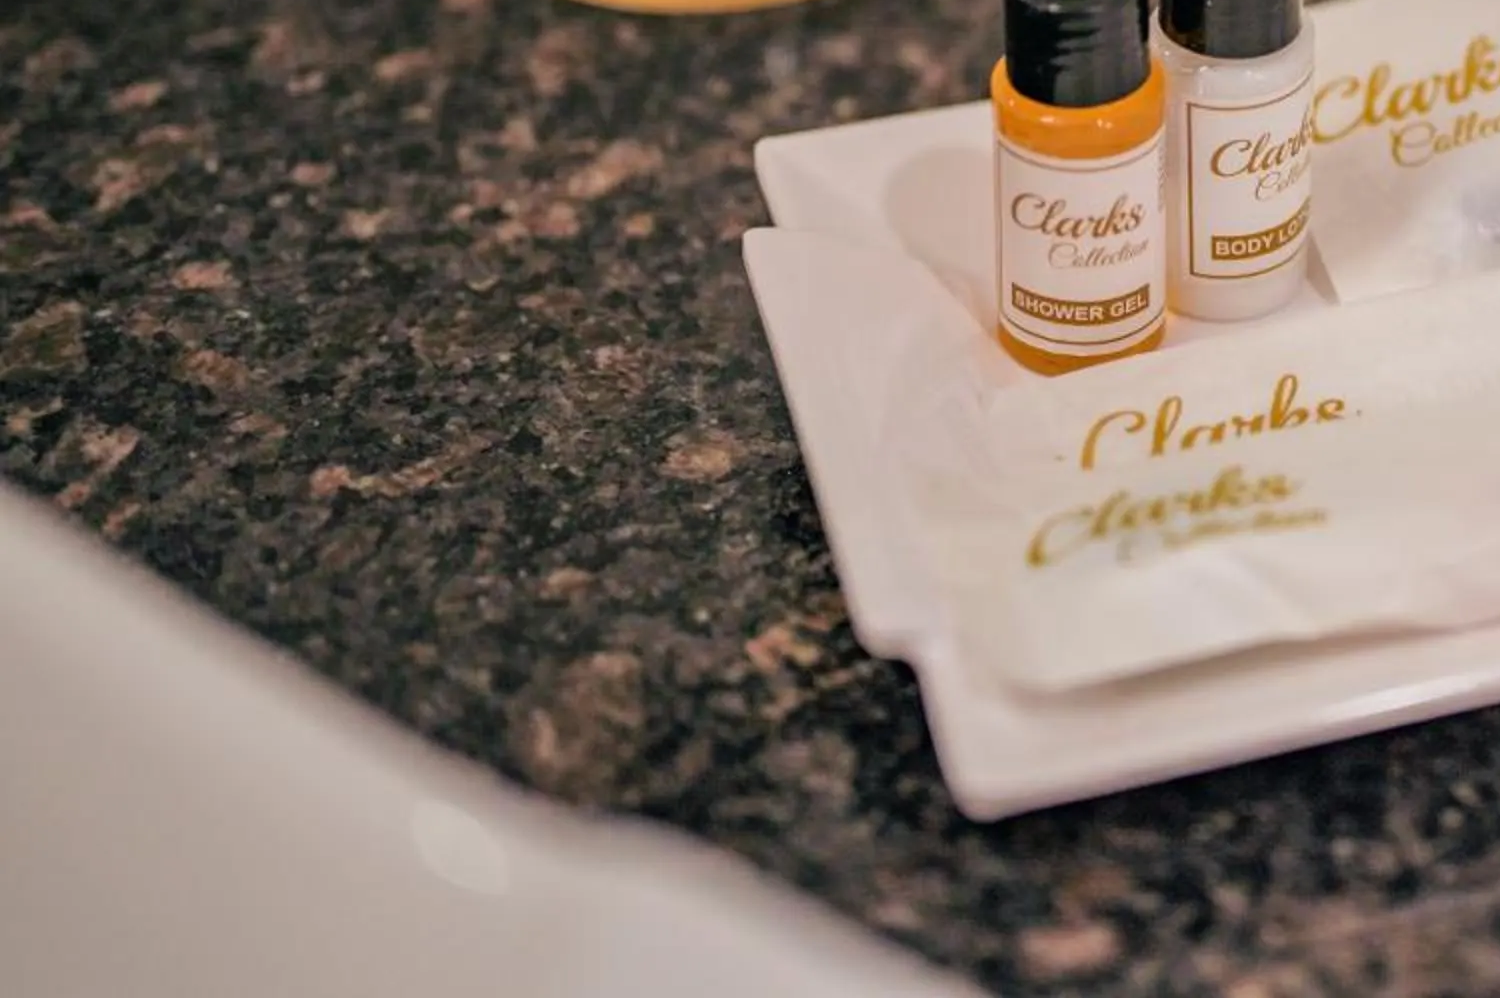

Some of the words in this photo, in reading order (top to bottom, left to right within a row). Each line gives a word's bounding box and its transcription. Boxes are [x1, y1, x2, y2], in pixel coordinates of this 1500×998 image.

[1010, 191, 1146, 240] Clarks
[1047, 240, 1149, 271] Collection
[1214, 229, 1274, 256] BODY
[1013, 290, 1104, 321] SHOWER
[1109, 294, 1149, 317] GEL
